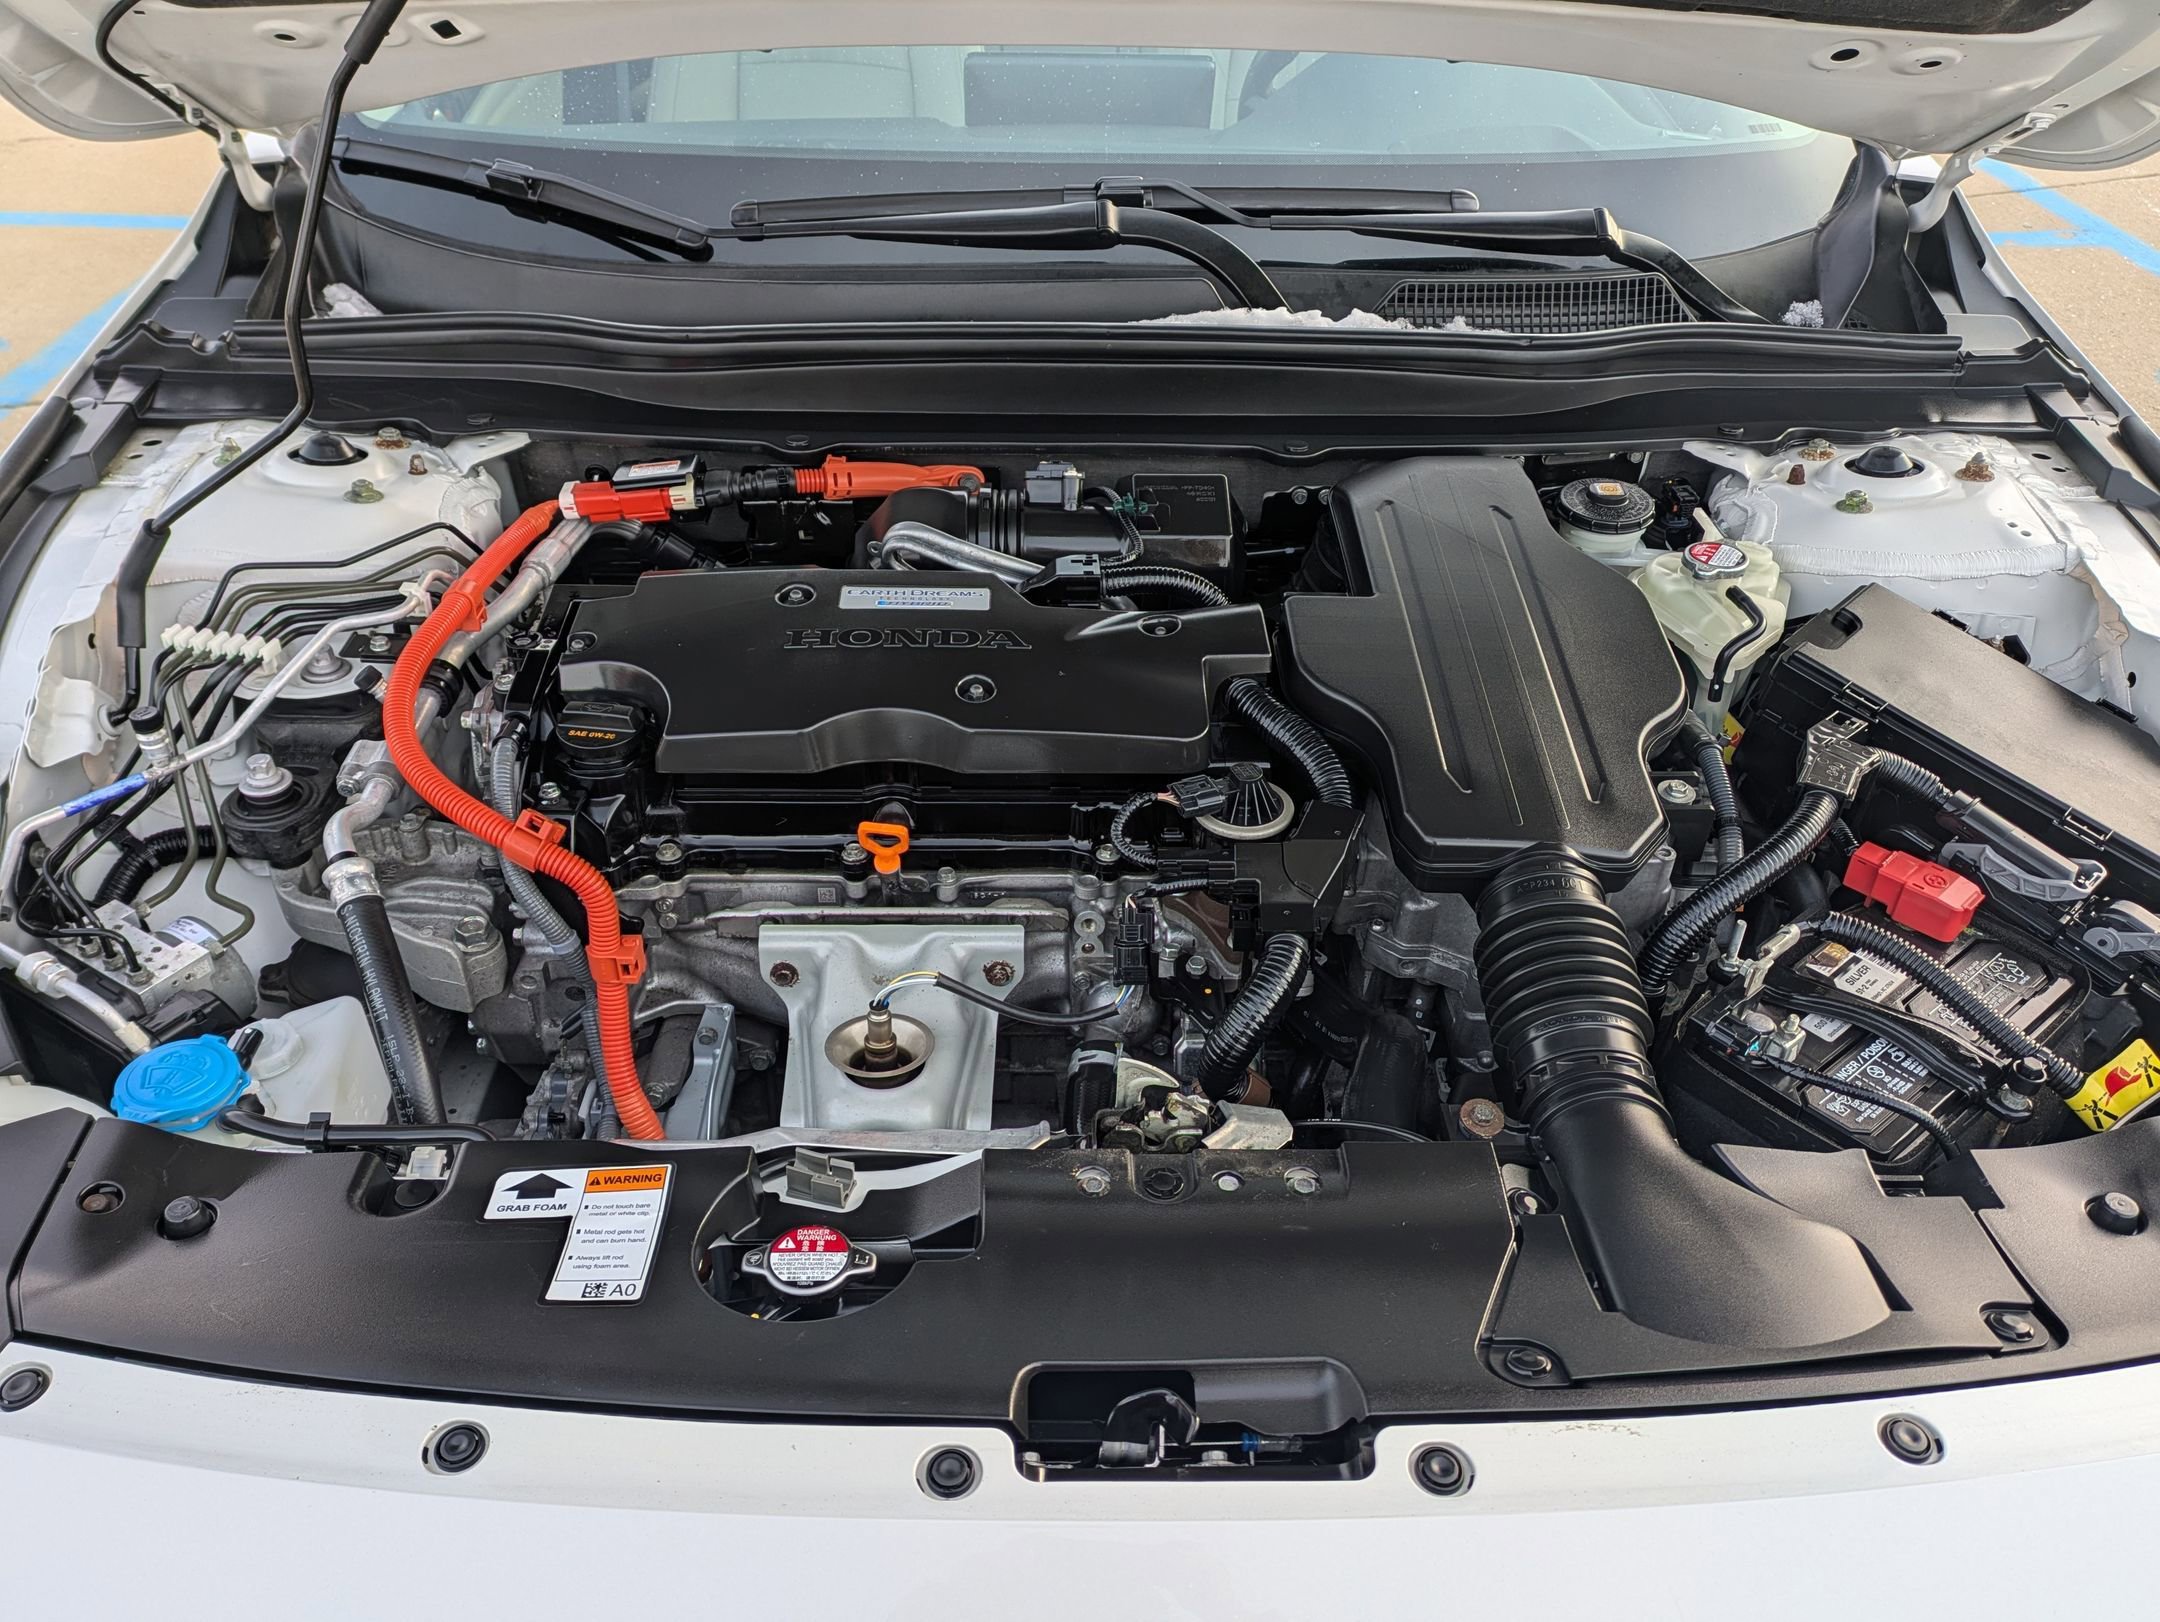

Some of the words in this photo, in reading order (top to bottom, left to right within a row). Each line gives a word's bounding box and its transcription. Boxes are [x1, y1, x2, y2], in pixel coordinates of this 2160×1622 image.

[847, 589, 907, 597] EARTH
[910, 589, 984, 597] DREAMS
[783, 628, 1032, 649] HONDA
[568, 729, 588, 737] SAE
[588, 731, 616, 740] 0W-20
[1845, 964, 1871, 986] SILVER
[604, 1173, 662, 1185] WARNING
[496, 1204, 530, 1213] GRAB
[533, 1203, 568, 1212] FOAM
